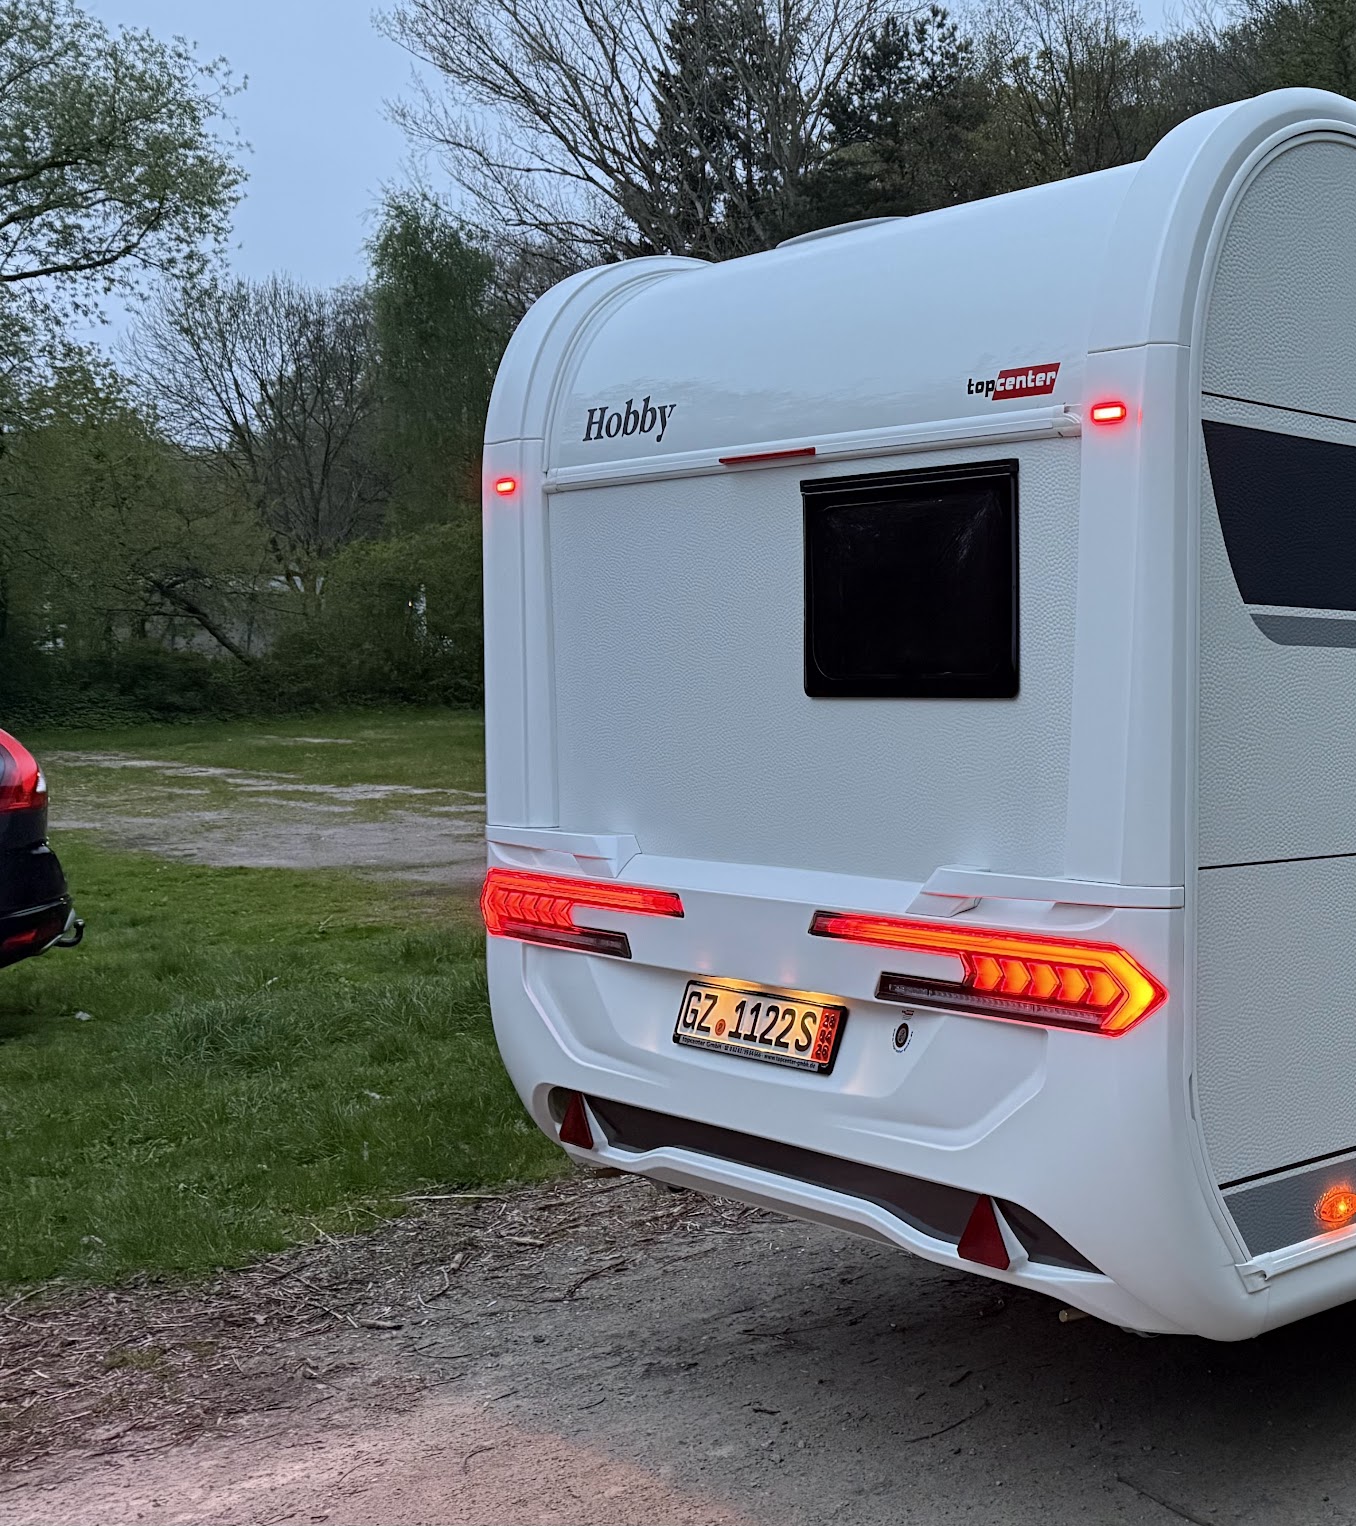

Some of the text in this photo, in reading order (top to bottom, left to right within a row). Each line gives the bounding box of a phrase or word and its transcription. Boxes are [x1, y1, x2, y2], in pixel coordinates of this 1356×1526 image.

[967, 370, 1056, 397] topcenter
[582, 395, 677, 442] Hobby
[682, 990, 719, 1033] GZ
